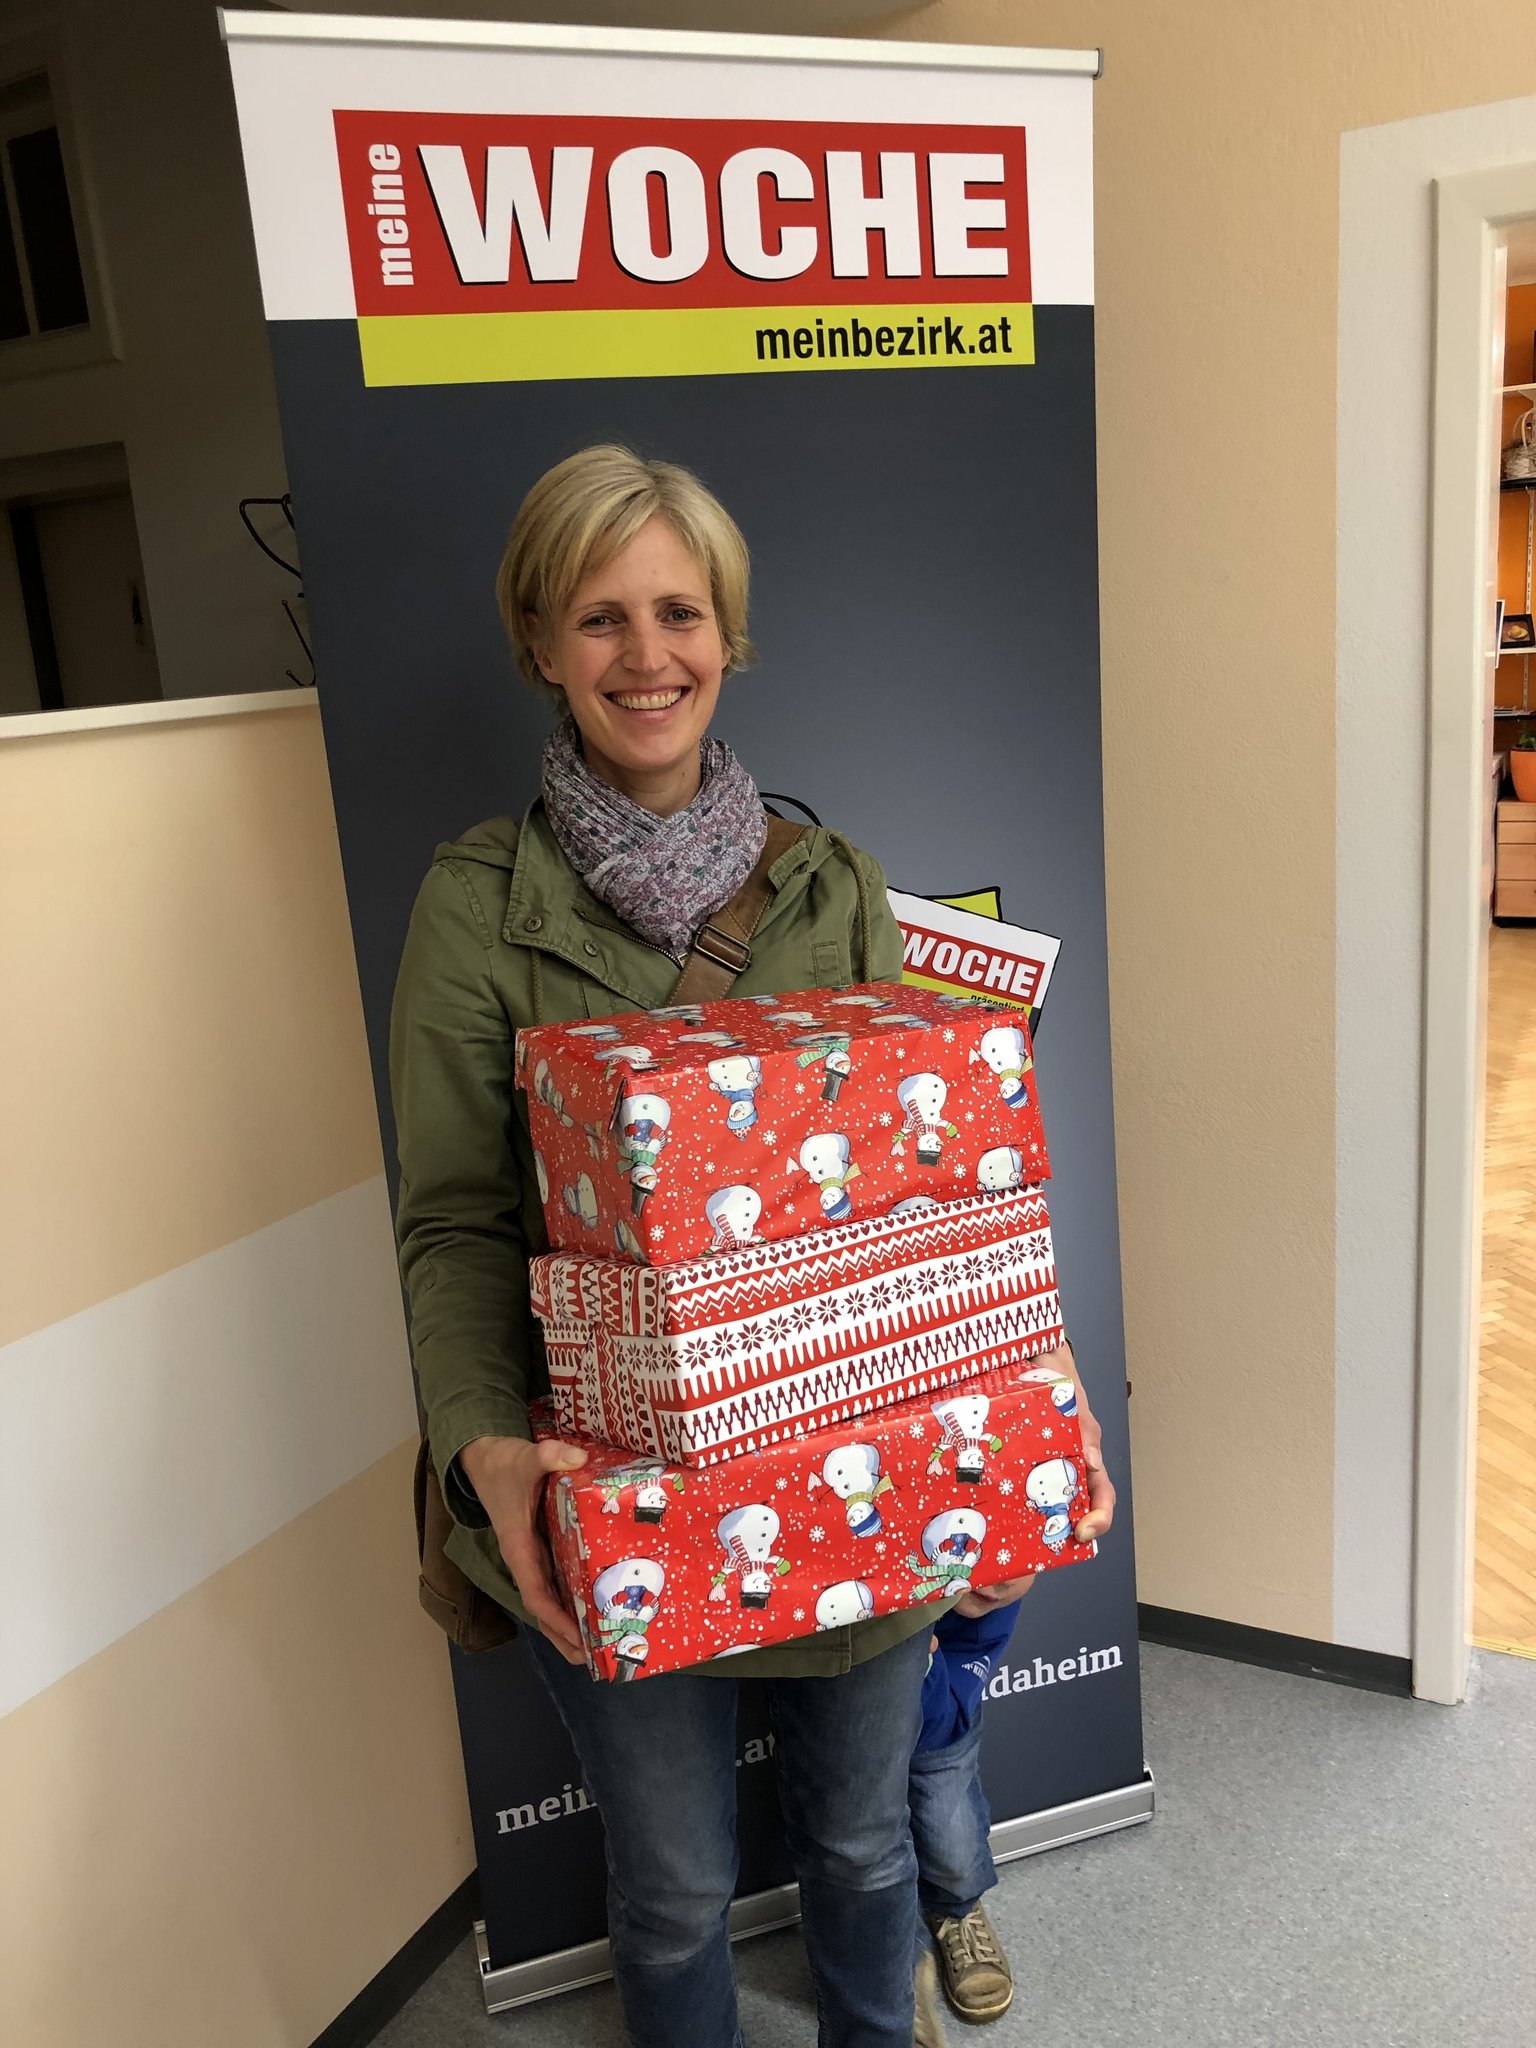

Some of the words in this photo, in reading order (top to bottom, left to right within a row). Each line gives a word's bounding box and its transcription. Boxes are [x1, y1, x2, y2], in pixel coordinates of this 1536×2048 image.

[367, 143, 414, 286] meine
[416, 144, 1010, 285] WOCHE
[755, 316, 1013, 360] meinbezirk.at
[900, 928, 1038, 998] WOCHE
